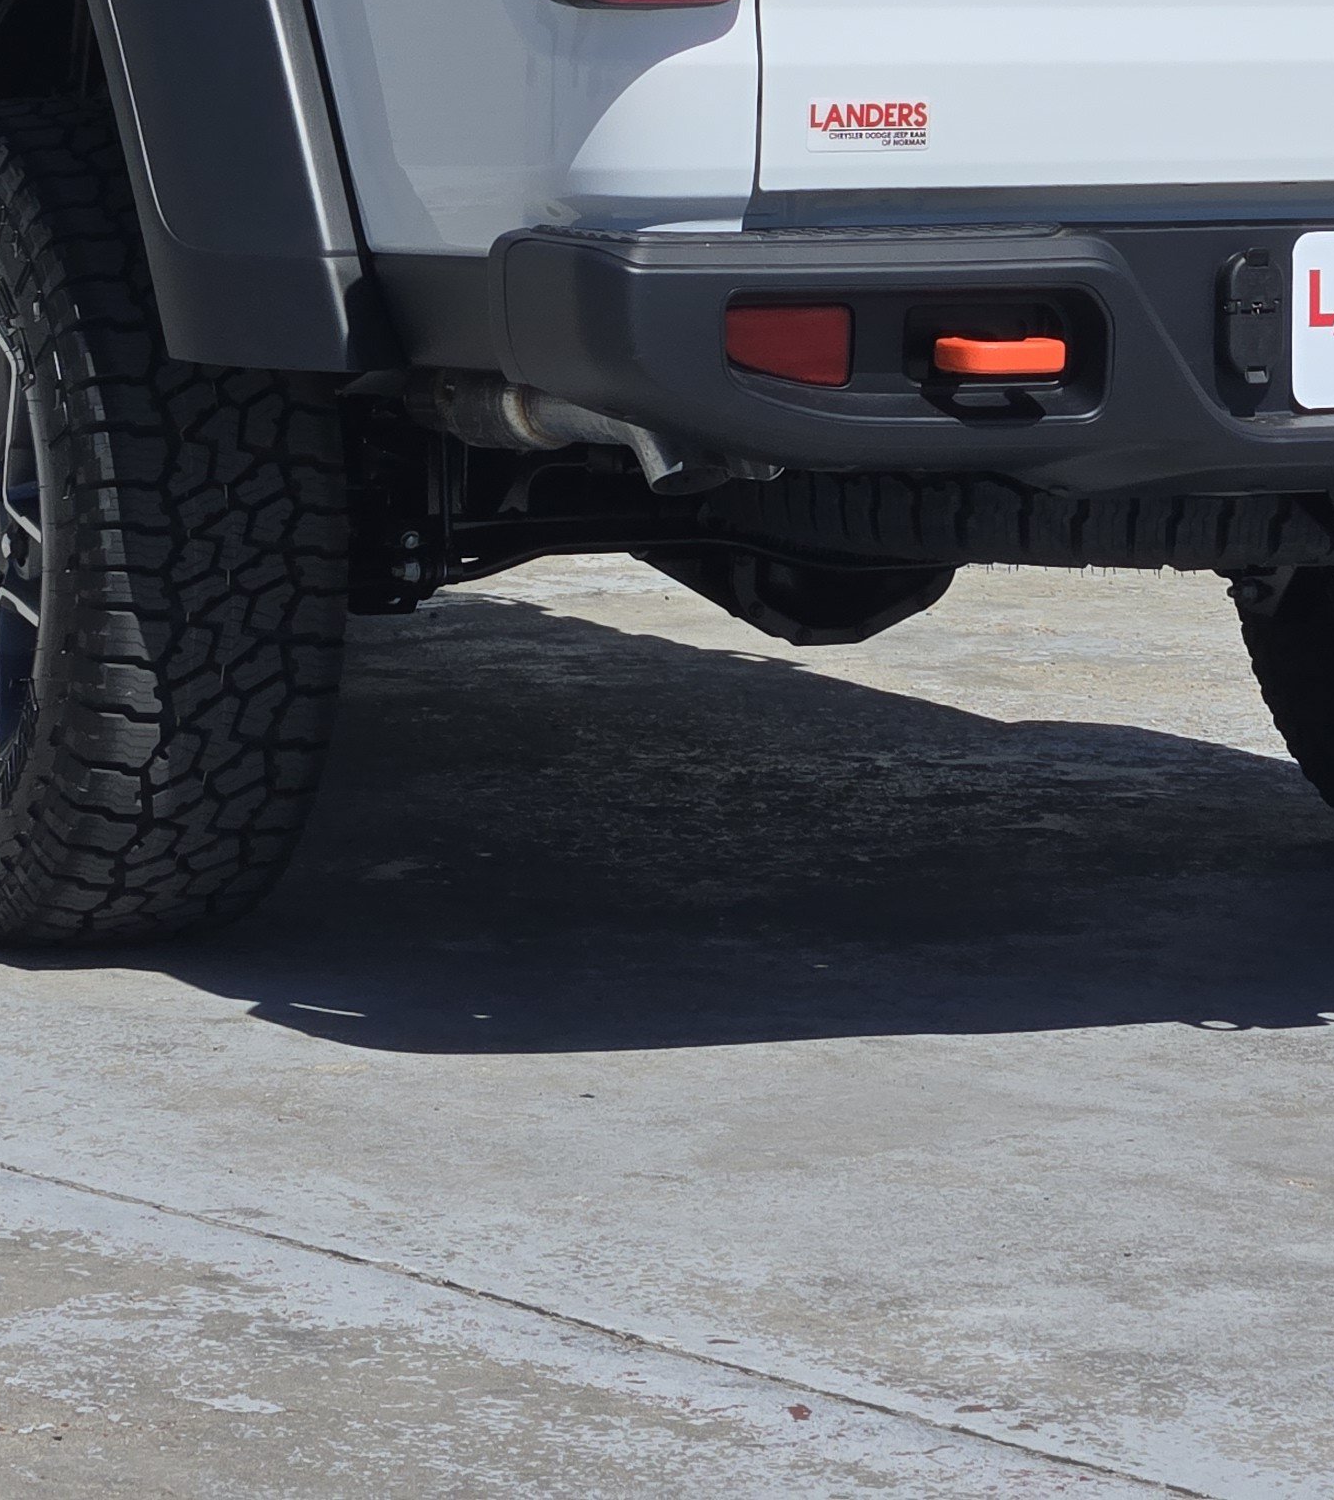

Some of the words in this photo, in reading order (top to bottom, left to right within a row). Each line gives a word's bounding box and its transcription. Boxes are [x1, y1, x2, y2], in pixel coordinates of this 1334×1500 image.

[810, 102, 928, 131] LANDERS
[829, 132, 863, 140] CHRYSLER
[893, 131, 908, 139] JEEP
[893, 138, 926, 146] NORMAN
